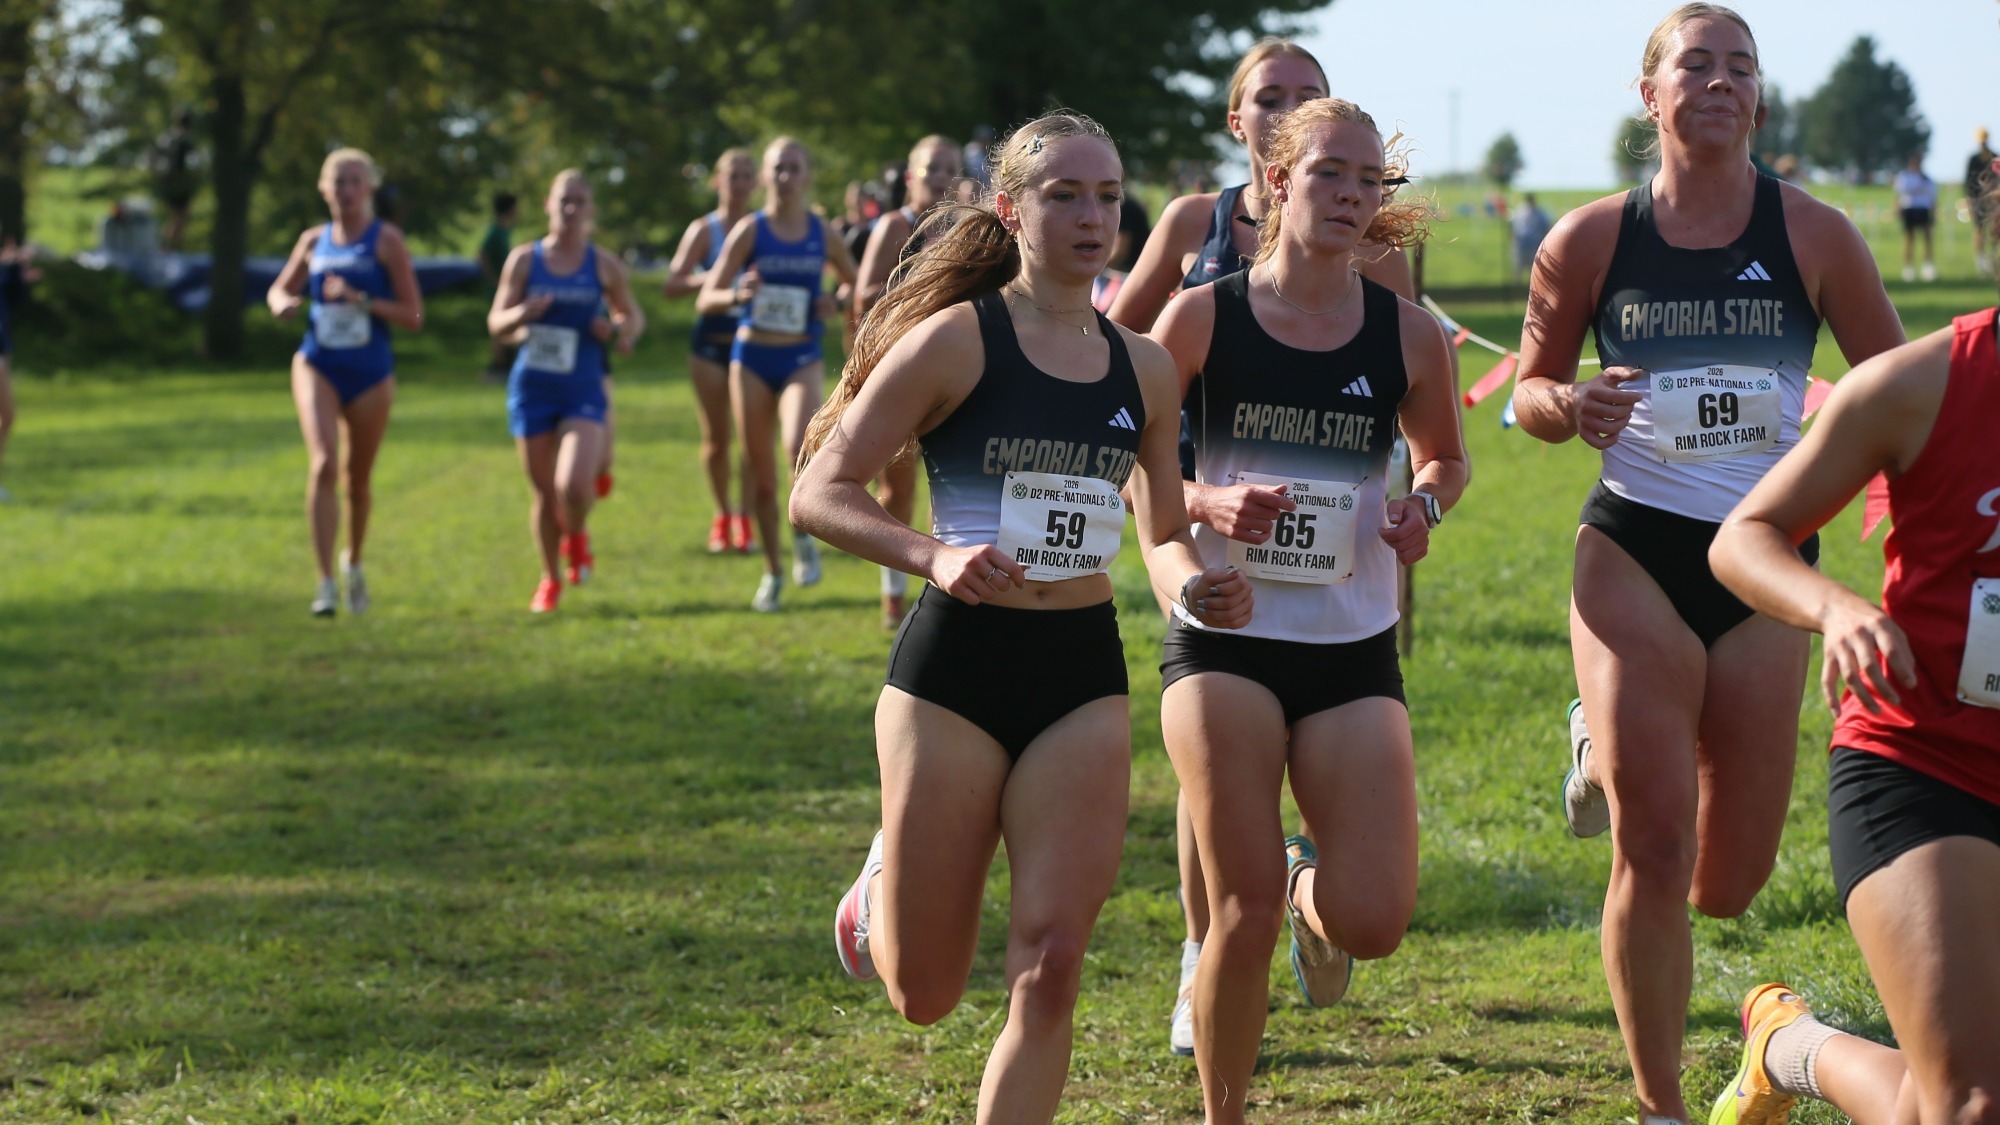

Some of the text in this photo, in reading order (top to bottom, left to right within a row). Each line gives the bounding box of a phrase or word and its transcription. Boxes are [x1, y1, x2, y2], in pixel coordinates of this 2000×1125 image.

[1621, 299, 1783, 341] EMPORIA STATE
[1707, 367, 1724, 376] 2026
[1676, 377, 1754, 390] D2 PRE-NATIONALS
[1697, 391, 1739, 429] 69
[1233, 402, 1375, 452] EMPORIA STATE
[1675, 426, 1766, 451] RIM ROCK FARM
[983, 437, 1138, 489] EMPORIA STAT
[1063, 479, 1080, 489] 2026
[1293, 482, 1310, 492] 2026
[1030, 488, 1106, 506] D2 PRE-NATIONALS
[1045, 509, 1087, 549] 59
[1274, 511, 1317, 549] 65
[1015, 547, 1102, 570] RIM ROCK FARM
[1245, 547, 1336, 570] RIM ROCK FARM
[1984, 673, 2000, 692] RI
